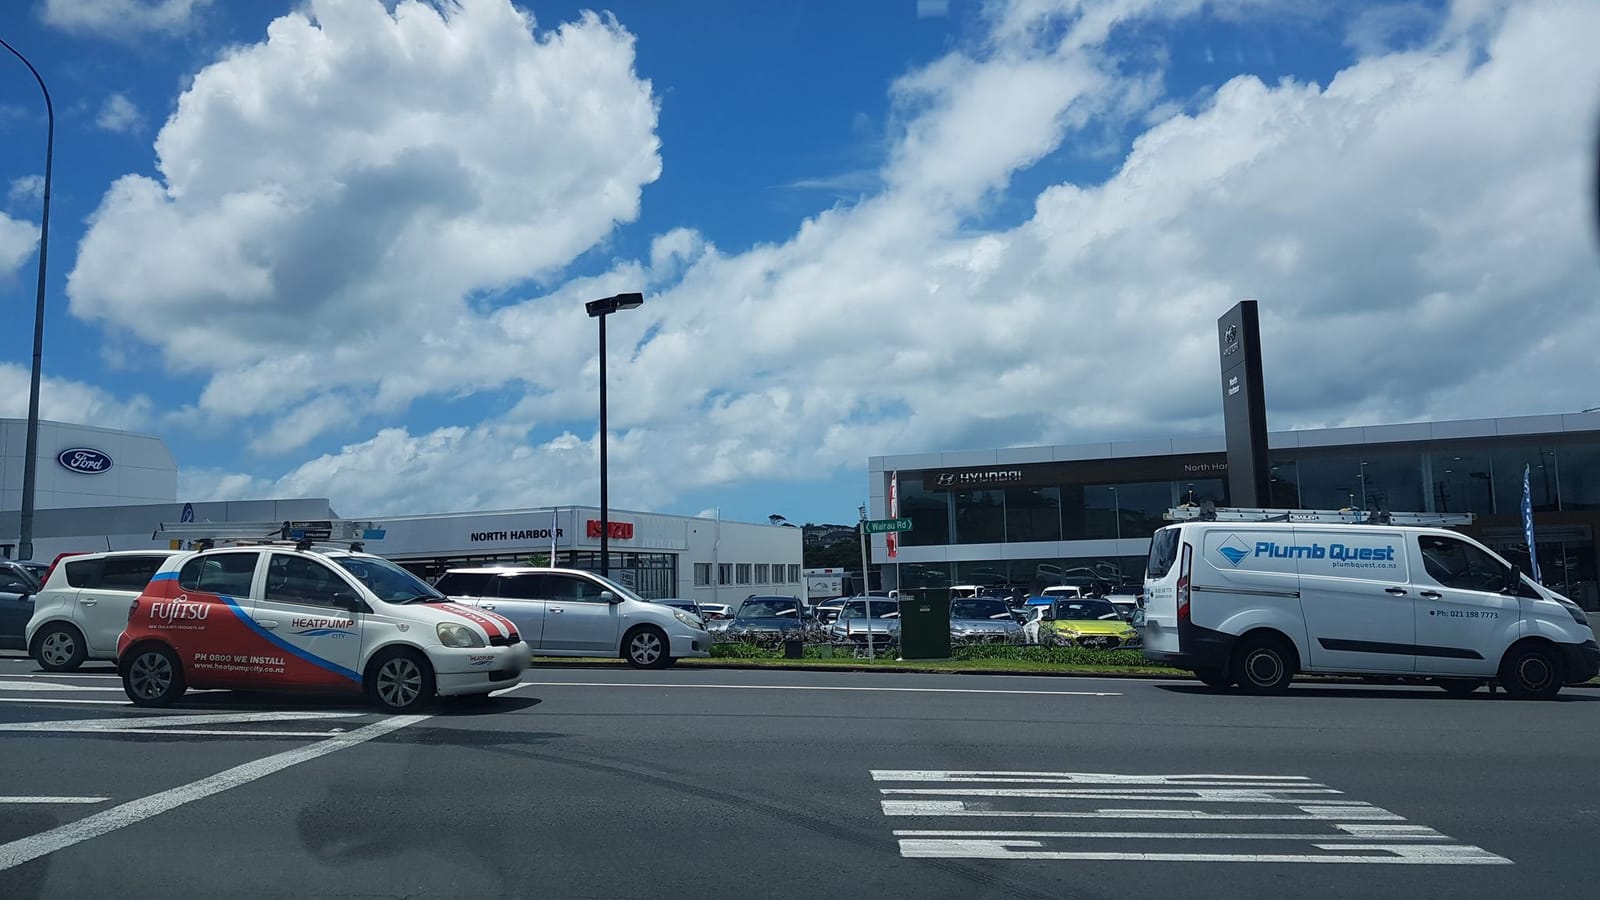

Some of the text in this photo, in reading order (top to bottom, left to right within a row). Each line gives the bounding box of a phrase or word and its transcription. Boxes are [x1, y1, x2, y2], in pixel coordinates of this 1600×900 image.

[71, 452, 104, 469] Ford
[960, 470, 1021, 483] HYUNDAI
[871, 521, 907, 531] Wairau Rd
[471, 531, 507, 542] NORTH
[1254, 541, 1395, 562] Plumb Quest
[1332, 561, 1397, 569] plumbquest.co.nz
[150, 594, 211, 624] FUJITSU
[1481, 611, 1499, 619] 7773
[292, 618, 354, 629] HEATPUMP
[194, 653, 286, 666] PH 0800 WE INSTALL
[194, 662, 285, 673] www.heatpumpcity.co.nz
